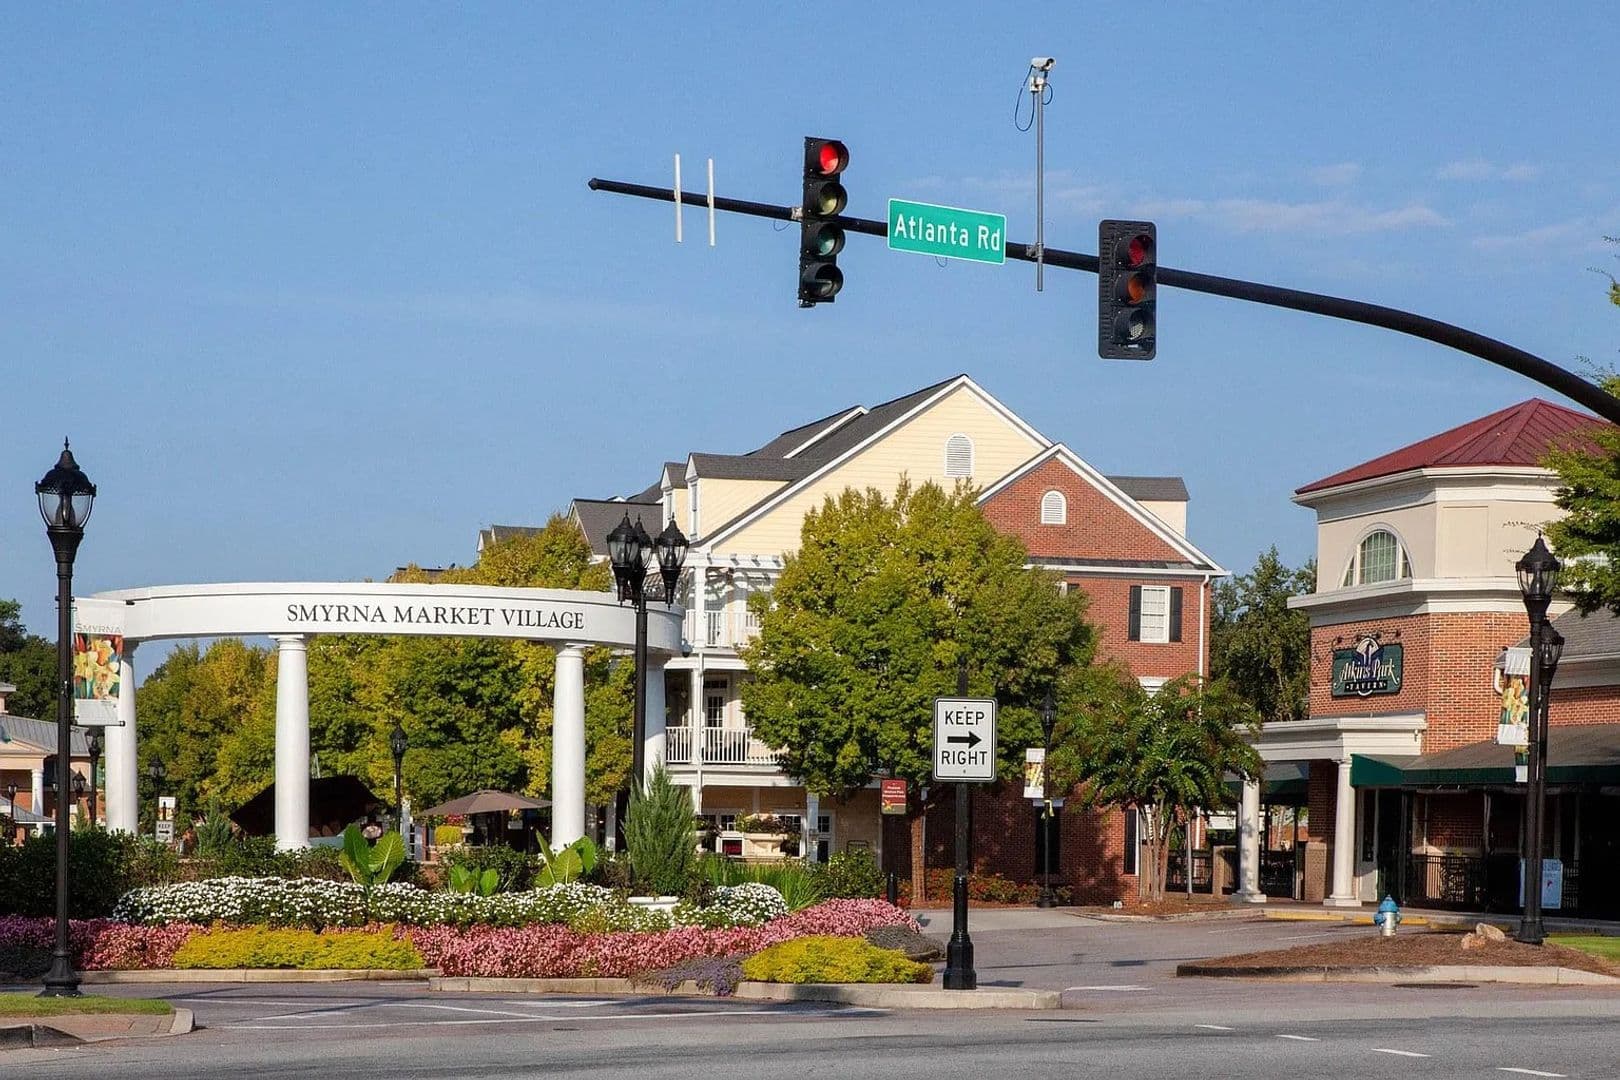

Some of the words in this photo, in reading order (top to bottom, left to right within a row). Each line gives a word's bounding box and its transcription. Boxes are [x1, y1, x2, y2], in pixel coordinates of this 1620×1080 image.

[894, 213, 969, 247] Atlanta
[977, 225, 1001, 251] Rd
[287, 604, 387, 622] SMYRNA
[394, 605, 495, 626] MARKET
[500, 608, 585, 629] VILLAGE
[75, 623, 124, 633] SMYRNA
[1336, 660, 1371, 684] Atkins
[1372, 657, 1400, 685] Park
[1349, 682, 1383, 691] TAVERN
[945, 710, 985, 725] KEEP
[941, 750, 988, 765] RIGHT
